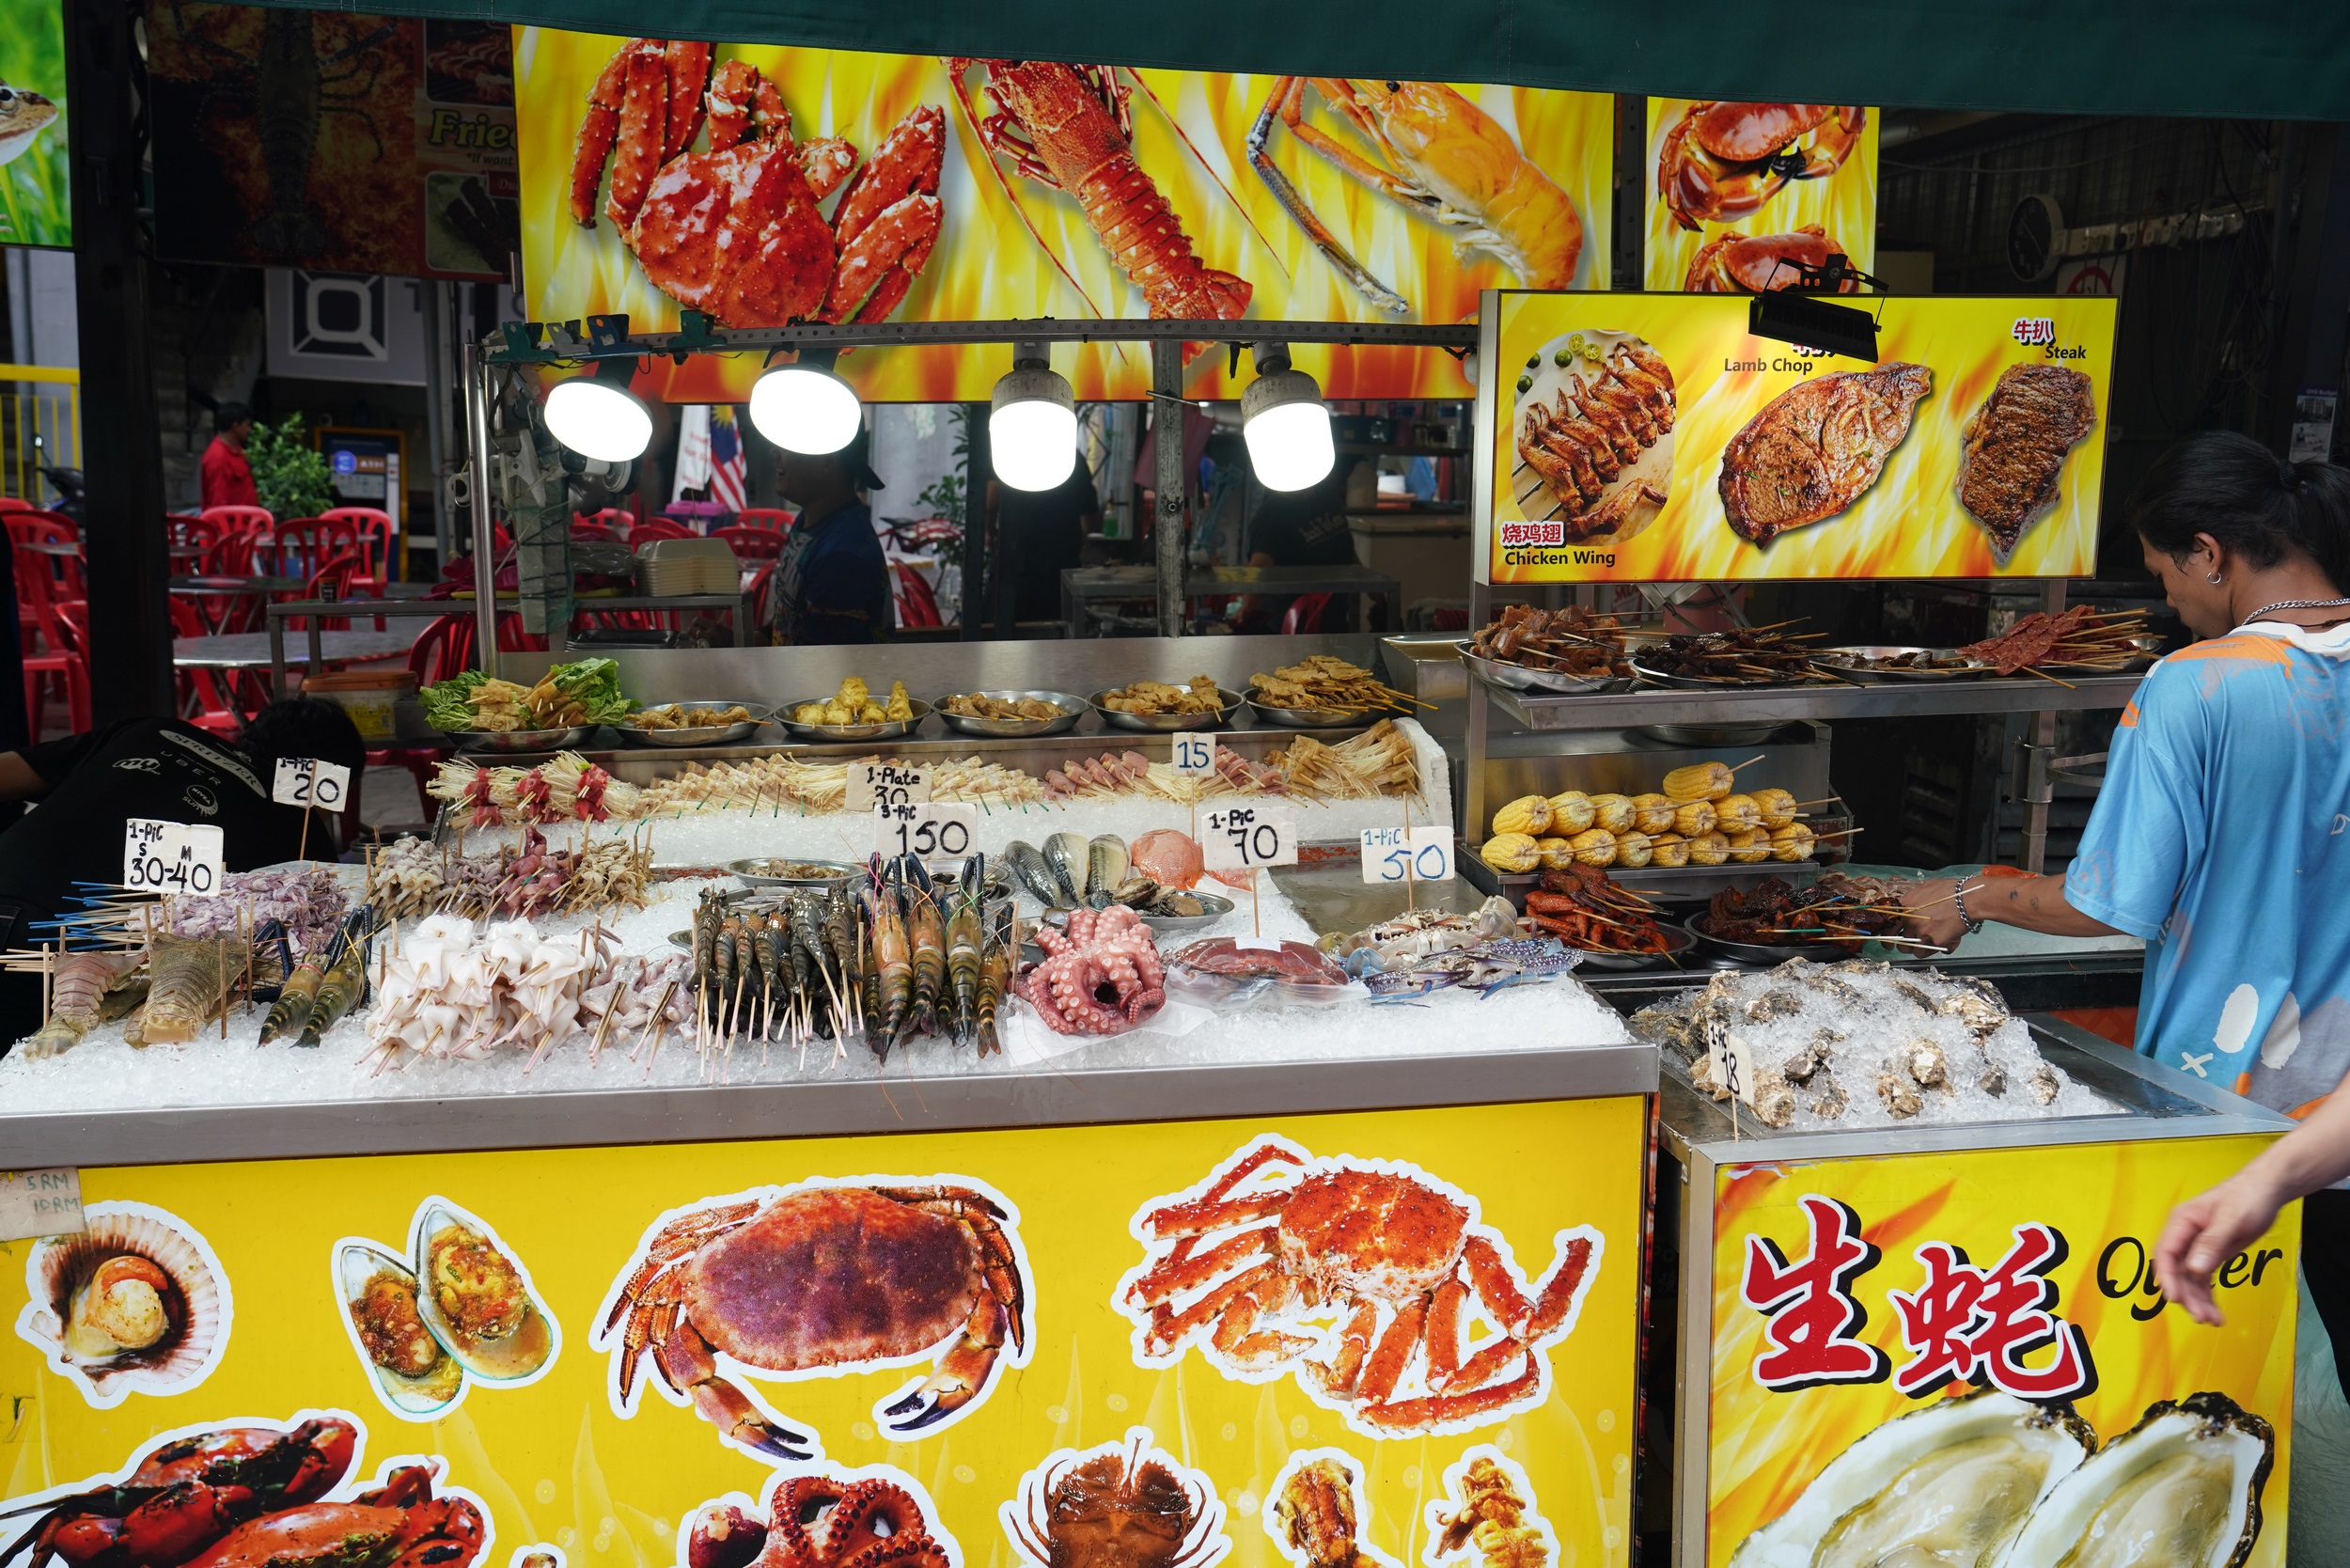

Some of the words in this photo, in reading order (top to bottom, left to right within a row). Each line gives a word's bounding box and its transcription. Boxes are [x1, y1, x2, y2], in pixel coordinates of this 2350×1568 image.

[483, 155, 513, 165] want
[2012, 318, 2053, 342] 牛扒
[2044, 345, 2087, 359] Steak
[1724, 358, 1767, 372] Lamb
[1772, 358, 1813, 376] Chop
[1500, 522, 1562, 544] 烧鸡翅
[1505, 551, 1568, 565] Chicken
[1574, 551, 1616, 568] Wing
[1177, 741, 1210, 769] 15
[191, 786, 212, 807] NIVEA
[293, 774, 339, 803] 20
[872, 785, 908, 809] 30
[139, 842, 147, 856] S
[180, 845, 192, 862] M
[896, 821, 969, 857] 150
[1228, 824, 1278, 865] 70
[130, 857, 212, 893] 30-40
[1382, 844, 1446, 881] 50
[1721, 1051, 1740, 1095] 18
[2096, 1236, 2283, 1321] Oyer
[1743, 1195, 2084, 1398] 生蚝
